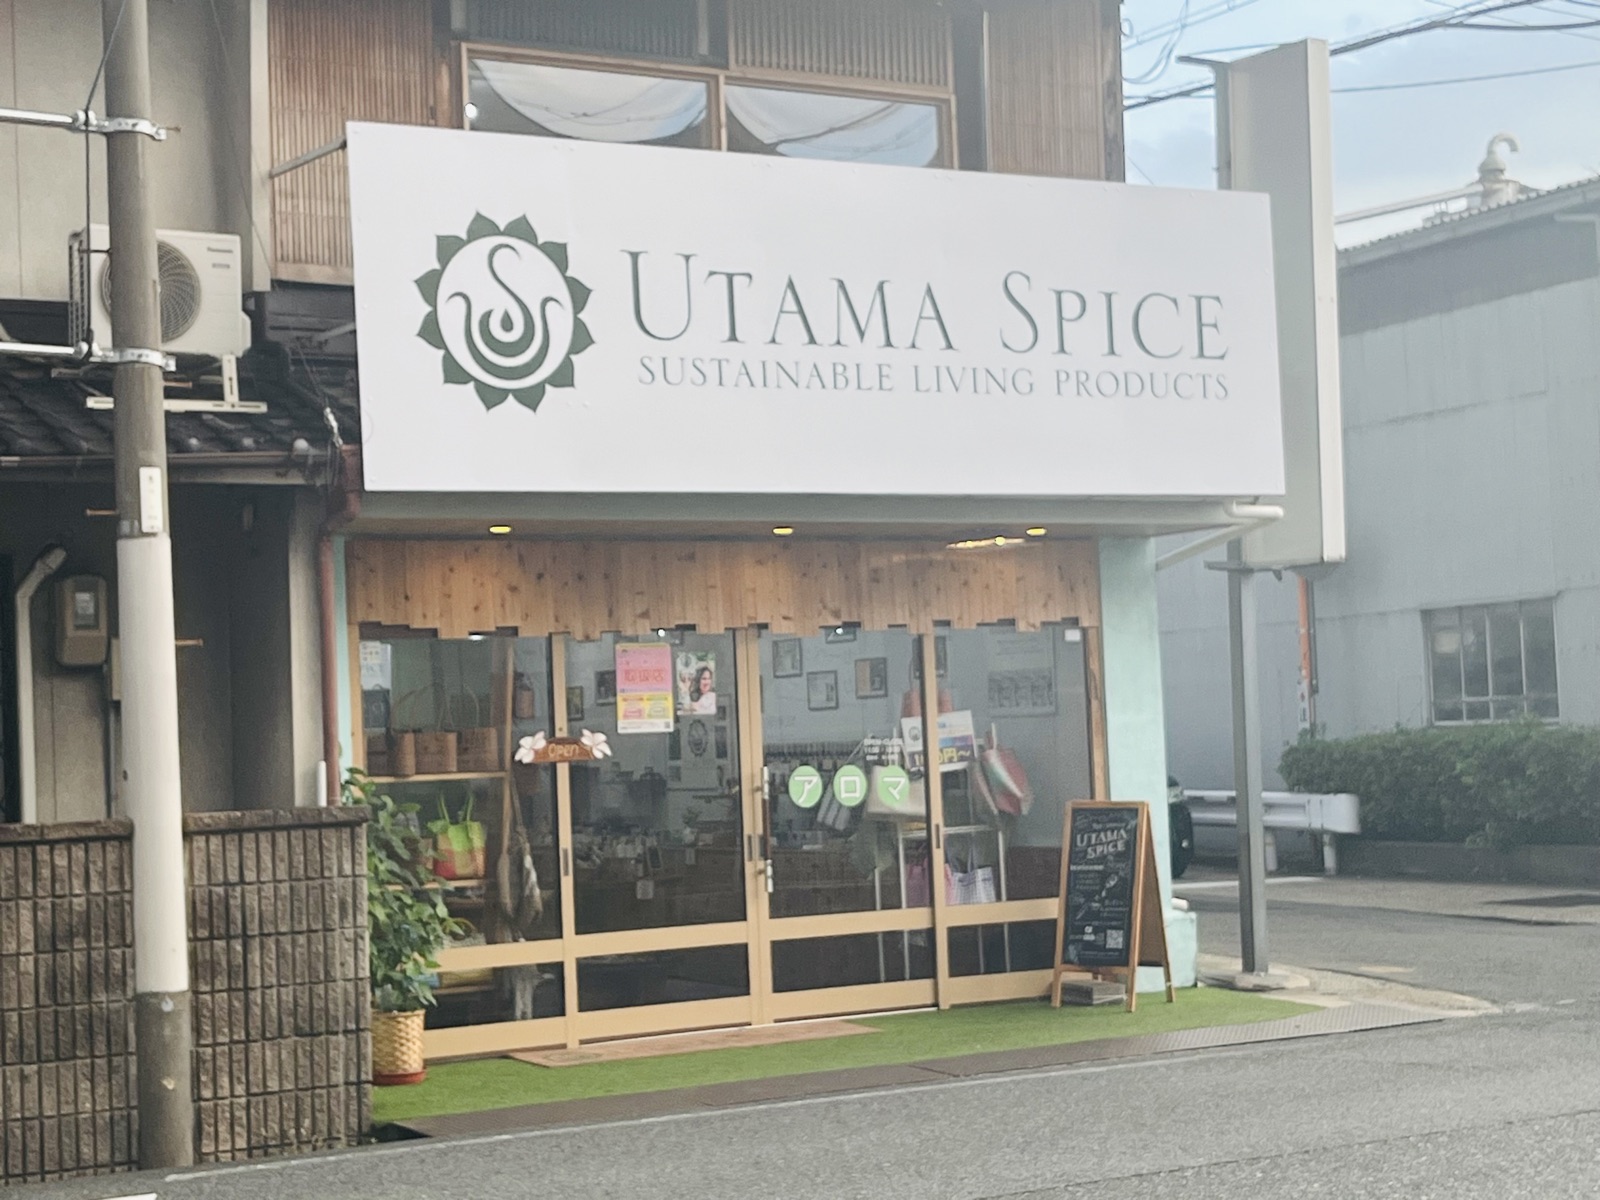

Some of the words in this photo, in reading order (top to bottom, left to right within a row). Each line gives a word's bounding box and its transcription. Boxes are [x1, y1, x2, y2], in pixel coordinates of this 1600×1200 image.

[620, 249, 960, 351] UTAMA
[1000, 270, 1229, 362] SPICE
[638, 355, 895, 393] SUSTAINABLE
[913, 363, 1035, 396] LIVING
[1055, 368, 1229, 401] PRODUCTS
[547, 743, 579, 758] Open
[793, 776, 906, 805] アロマ
[1076, 828, 1127, 847] UTAMA
[1086, 840, 1125, 859] SPICE
